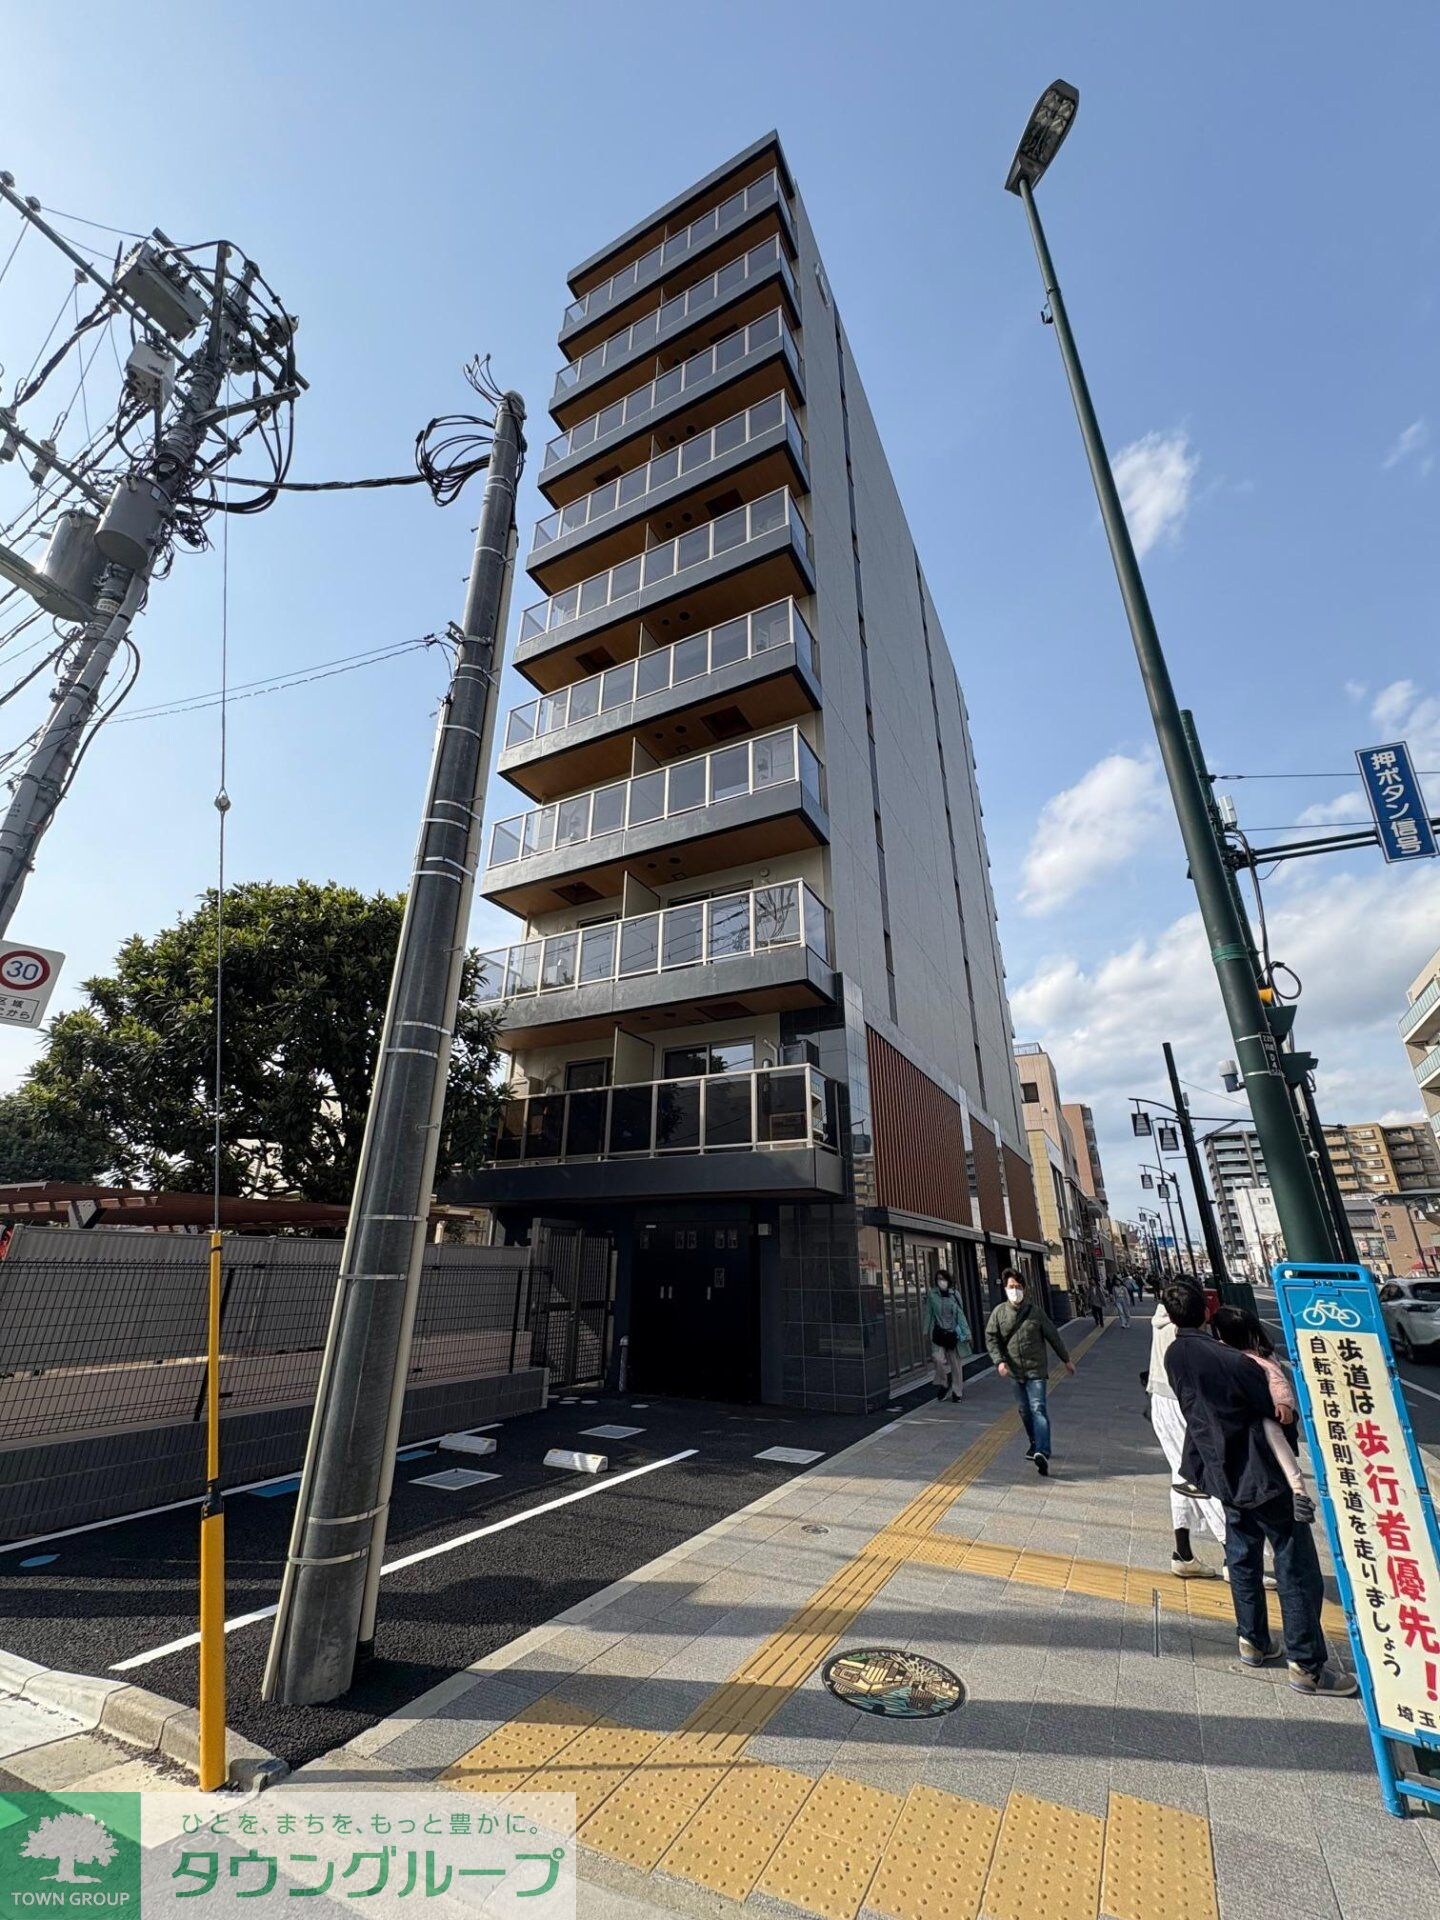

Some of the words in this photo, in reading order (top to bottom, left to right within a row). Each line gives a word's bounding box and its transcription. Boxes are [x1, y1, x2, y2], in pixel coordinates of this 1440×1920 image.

[1371, 751, 1422, 854] 押ボタン信号
[6, 960, 39, 980] 30
[1310, 1336, 1401, 1678] 自転車は原則車道を走りましょう
[1397, 1703, 1440, 1728] 埼玉
